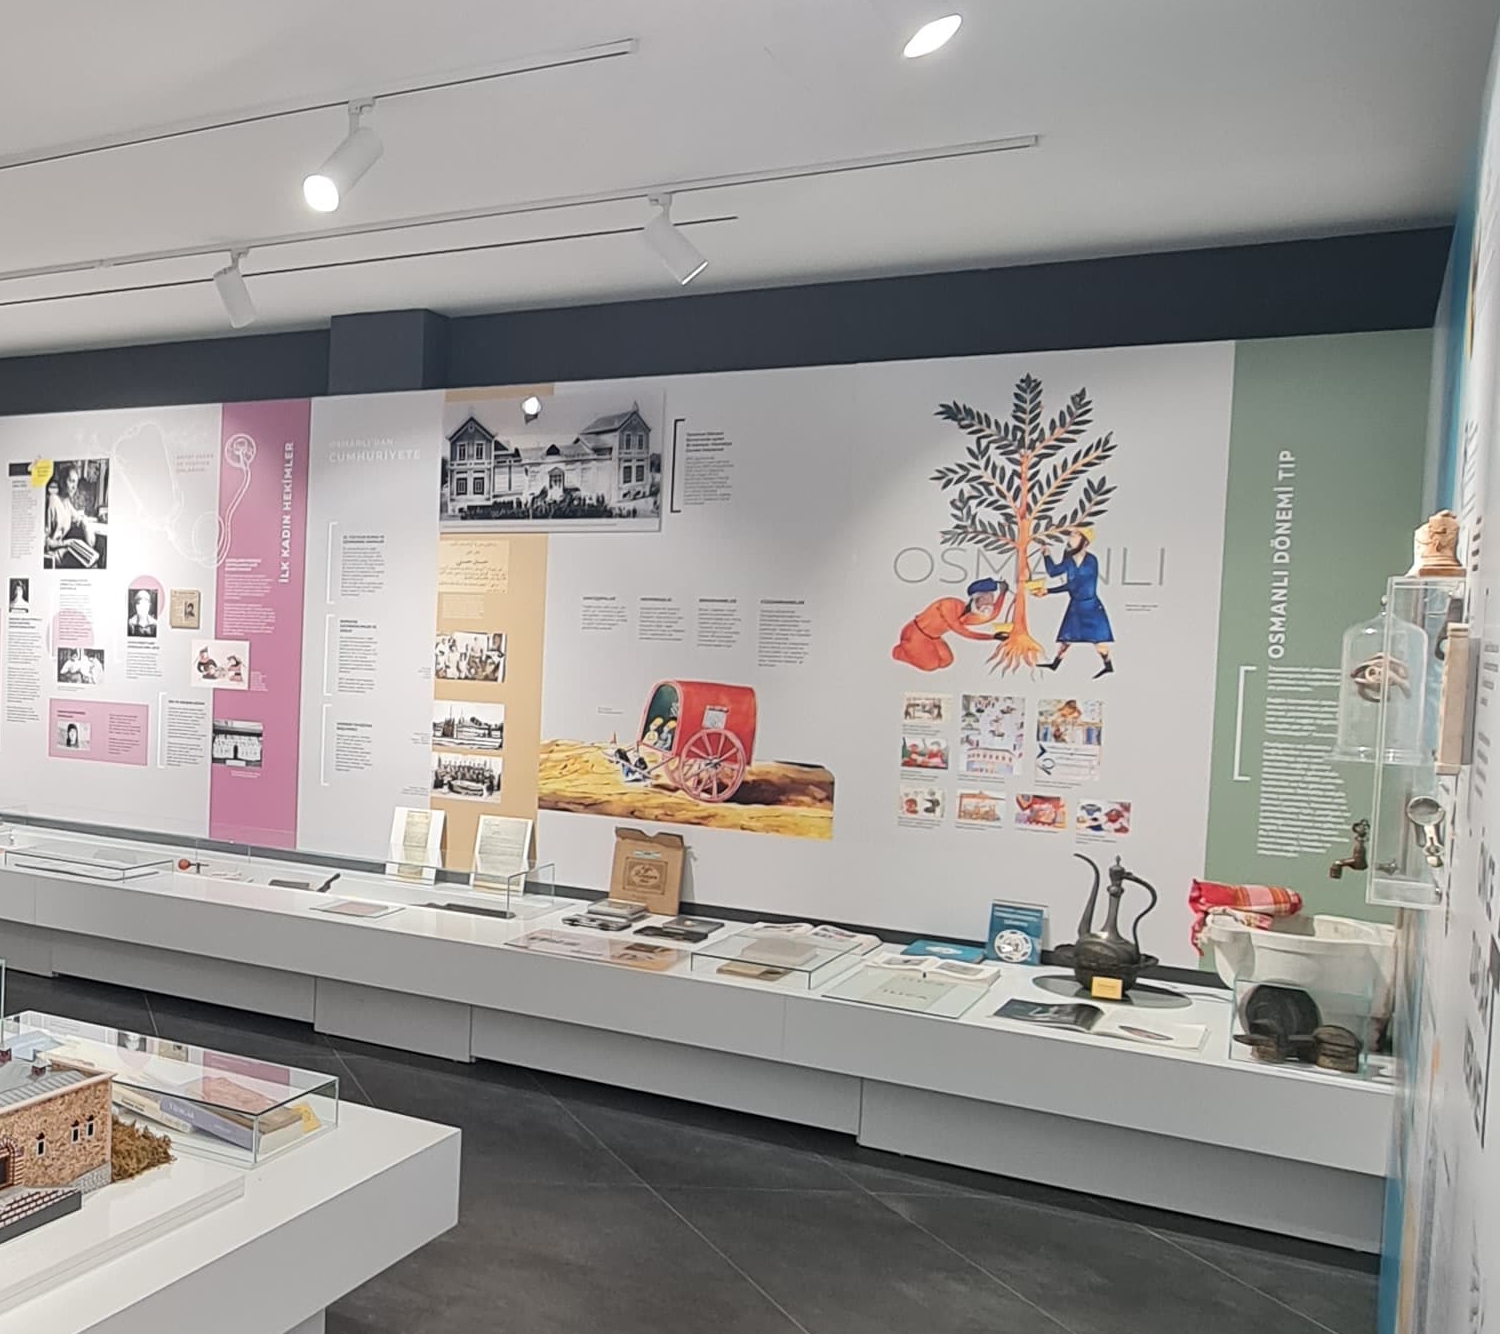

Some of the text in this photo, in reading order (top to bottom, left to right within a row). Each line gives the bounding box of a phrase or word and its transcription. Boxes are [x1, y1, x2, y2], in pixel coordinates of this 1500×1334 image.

[278, 442, 294, 583] İLK KADIN HEKİMLER
[1267, 450, 1296, 660] OSMANLI DÖNEMİ TIP
